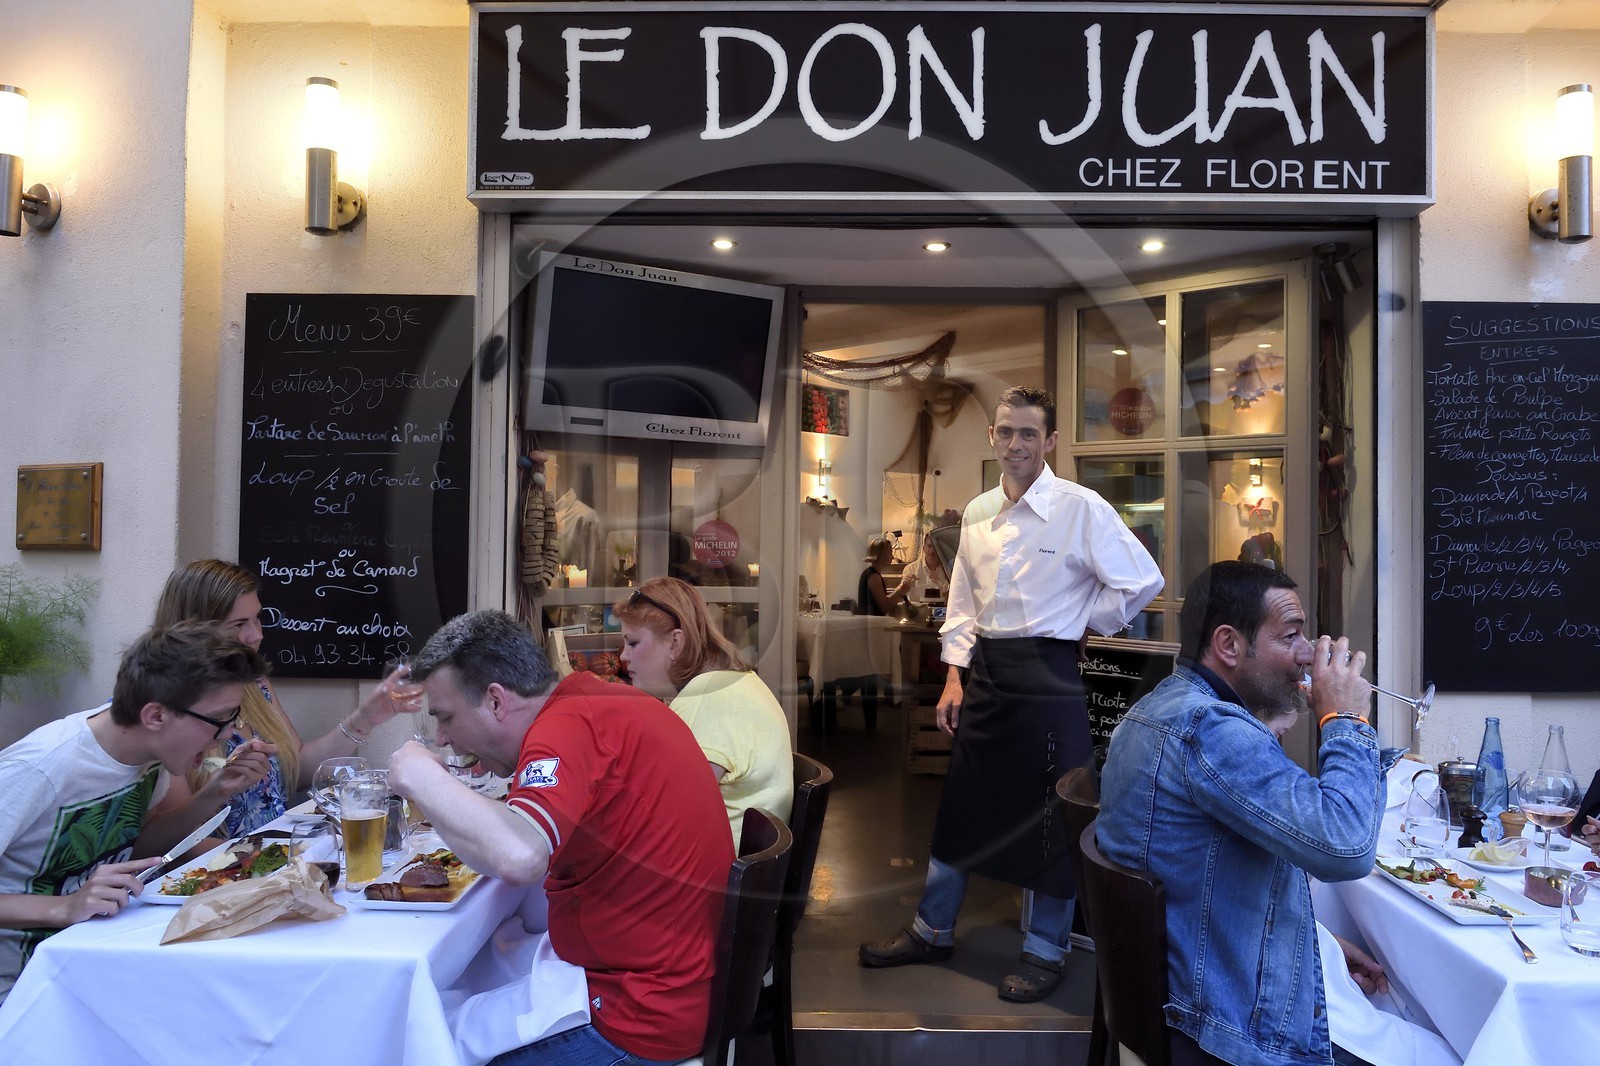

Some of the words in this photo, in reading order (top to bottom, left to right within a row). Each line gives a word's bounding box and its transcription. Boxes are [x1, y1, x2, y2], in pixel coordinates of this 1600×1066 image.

[501, 24, 651, 142] LE
[699, 22, 986, 142] DON
[1038, 22, 1388, 148] JUAN
[1079, 157, 1182, 188] CHEZ
[1206, 159, 1390, 190] FLORENT
[574, 258, 596, 270] Le
[600, 262, 634, 276] Don
[638, 268, 678, 283] Juan
[362, 305, 421, 341] 39€
[1446, 316, 1600, 339] SUGGESTIONS
[1480, 345, 1558, 360] ENTREES
[250, 368, 265, 400] 4
[1486, 387, 1498, 404] de
[1434, 406, 1482, 422] Avocat
[1526, 412, 1549, 422] au
[1552, 406, 1600, 422] Crabe
[307, 421, 326, 442] de
[646, 422, 685, 435] Chez
[689, 426, 742, 440] Florent
[1499, 424, 1537, 443] petits
[1478, 443, 1490, 460] de
[249, 461, 314, 496] Loup
[314, 492, 355, 514] Sel
[338, 550, 356, 558] ou
[259, 557, 326, 584] Magret
[326, 559, 346, 578] de
[352, 556, 420, 578] Canard
[1430, 556, 1457, 578] St
[262, 607, 337, 631] Dessert
[336, 626, 359, 636] au
[362, 613, 414, 638] choix
